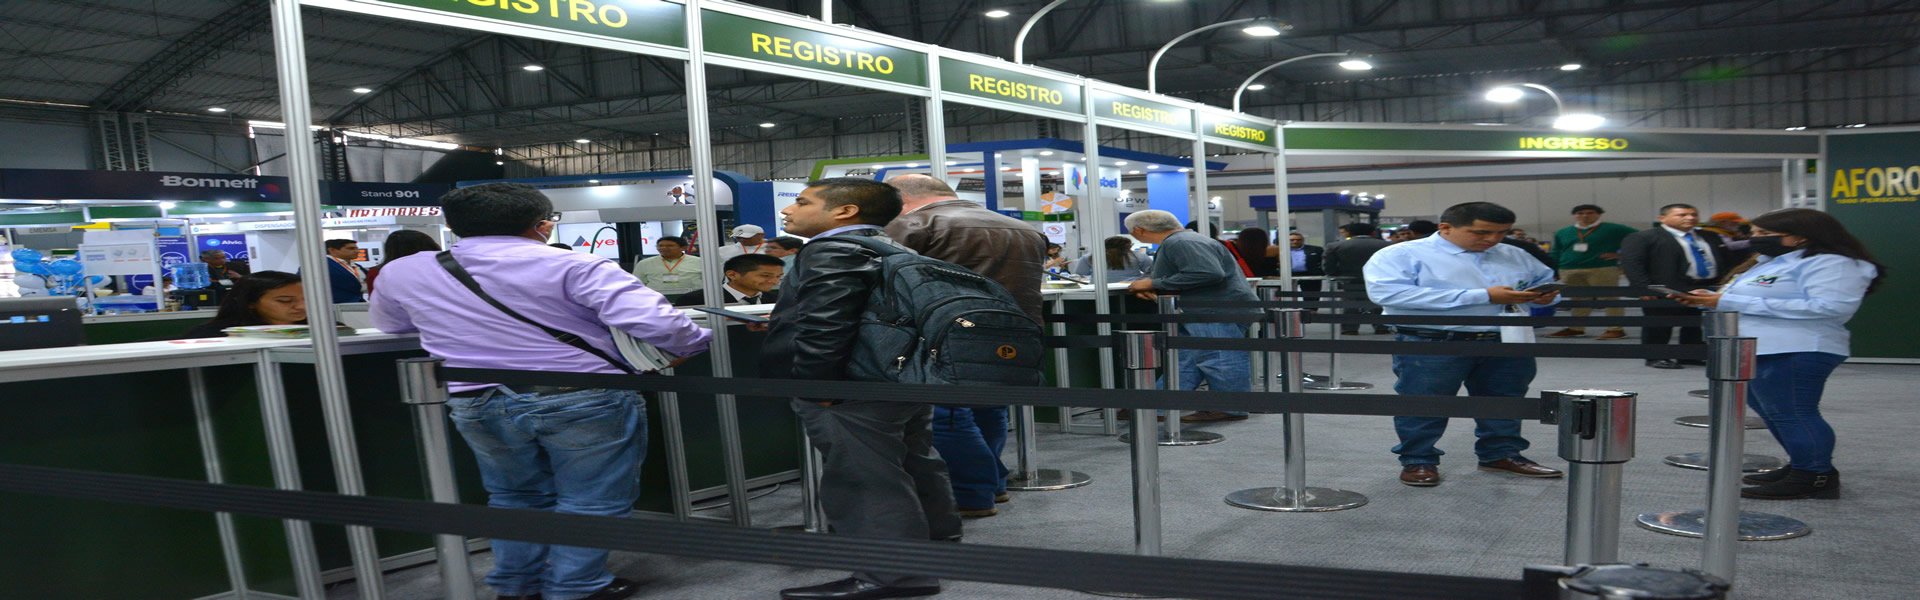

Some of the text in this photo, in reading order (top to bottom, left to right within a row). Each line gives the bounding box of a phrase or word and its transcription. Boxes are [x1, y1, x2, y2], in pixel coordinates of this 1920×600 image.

[751, 32, 894, 75] REGISTRO
[969, 73, 1063, 105] REGISTRO
[1215, 123, 1266, 142] REGISTRO
[1519, 137, 1628, 150] INGRESO
[160, 175, 258, 189] Bonnett
[1831, 166, 1920, 198] AFORO
[394, 190, 420, 198] 901
